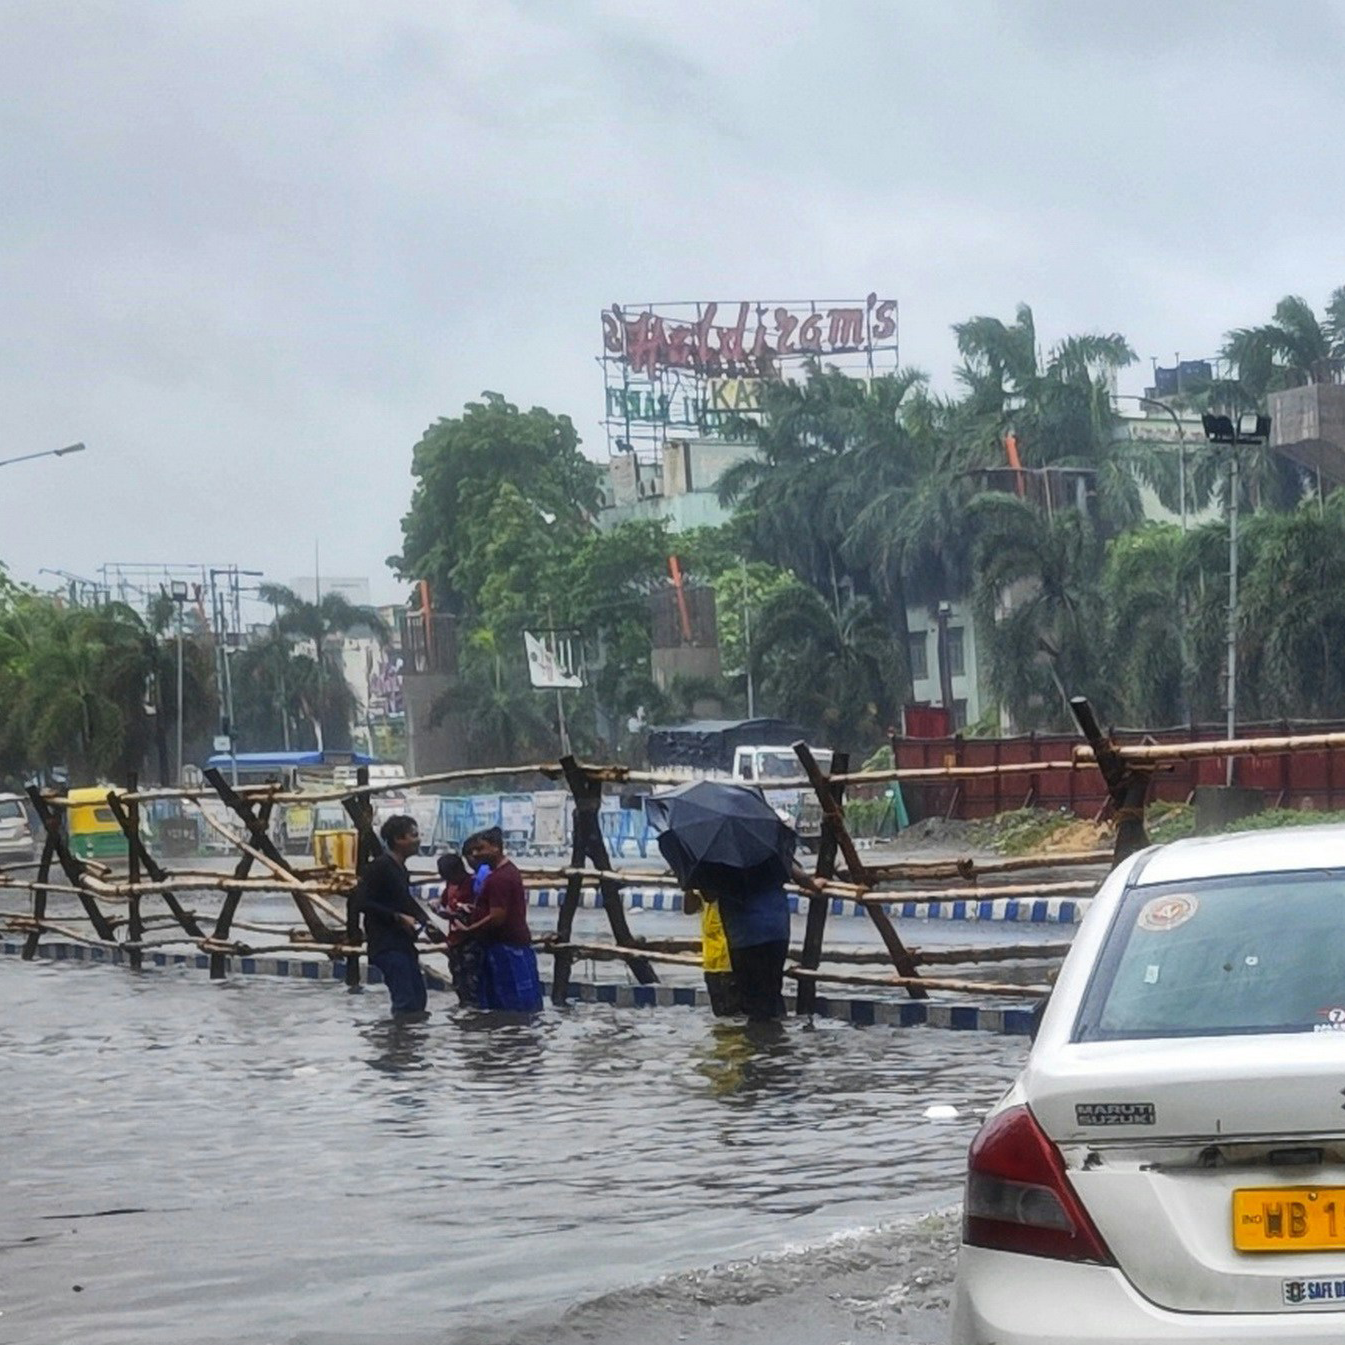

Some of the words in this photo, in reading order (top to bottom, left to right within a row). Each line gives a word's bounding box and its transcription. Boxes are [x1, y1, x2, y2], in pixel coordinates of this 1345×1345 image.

[1077, 1104, 1153, 1115] MARUTI
[1078, 1113, 1154, 1125] SUZUKI
[1307, 1281, 1333, 1299] SAFE
